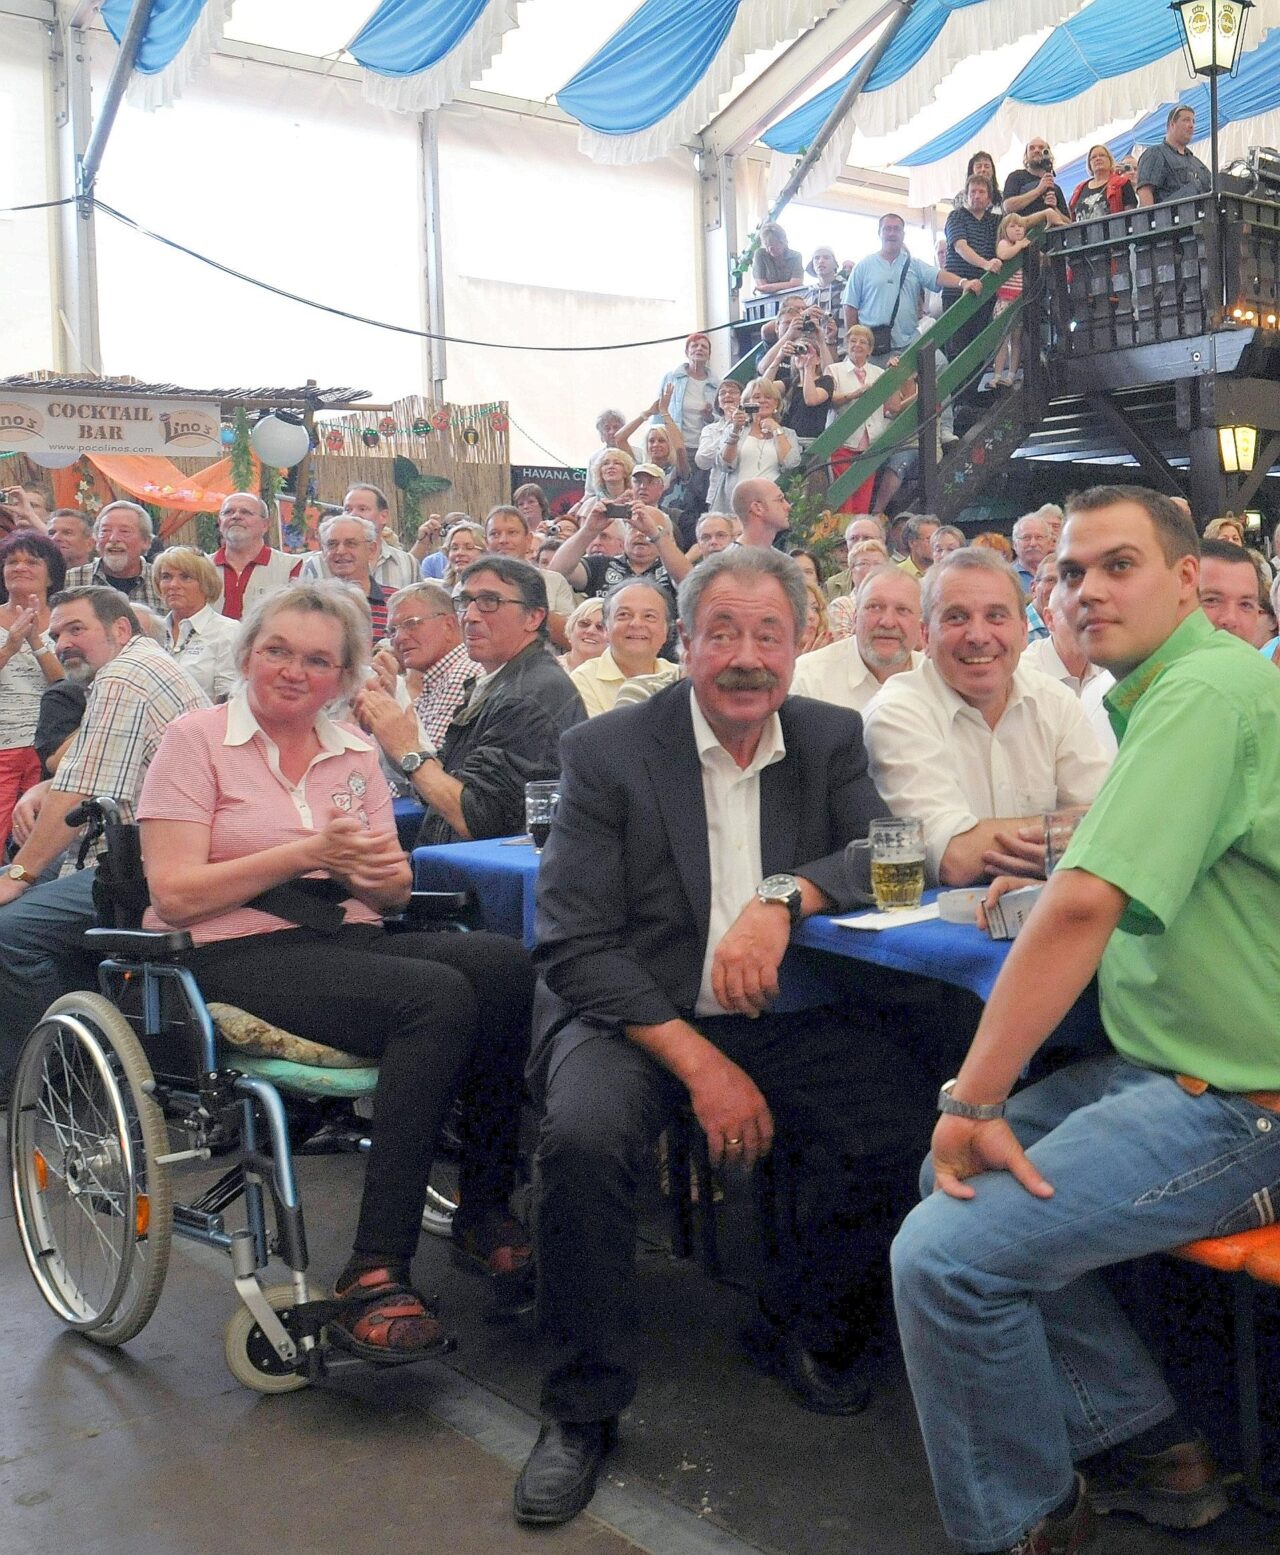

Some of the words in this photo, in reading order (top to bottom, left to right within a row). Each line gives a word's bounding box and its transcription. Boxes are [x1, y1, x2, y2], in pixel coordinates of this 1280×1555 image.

[47, 403, 153, 421] COCKTAIL
[78, 424, 124, 440] BAR
[48, 443, 154, 453] www.pocolinos.com
[523, 468, 570, 480] HAVANA
